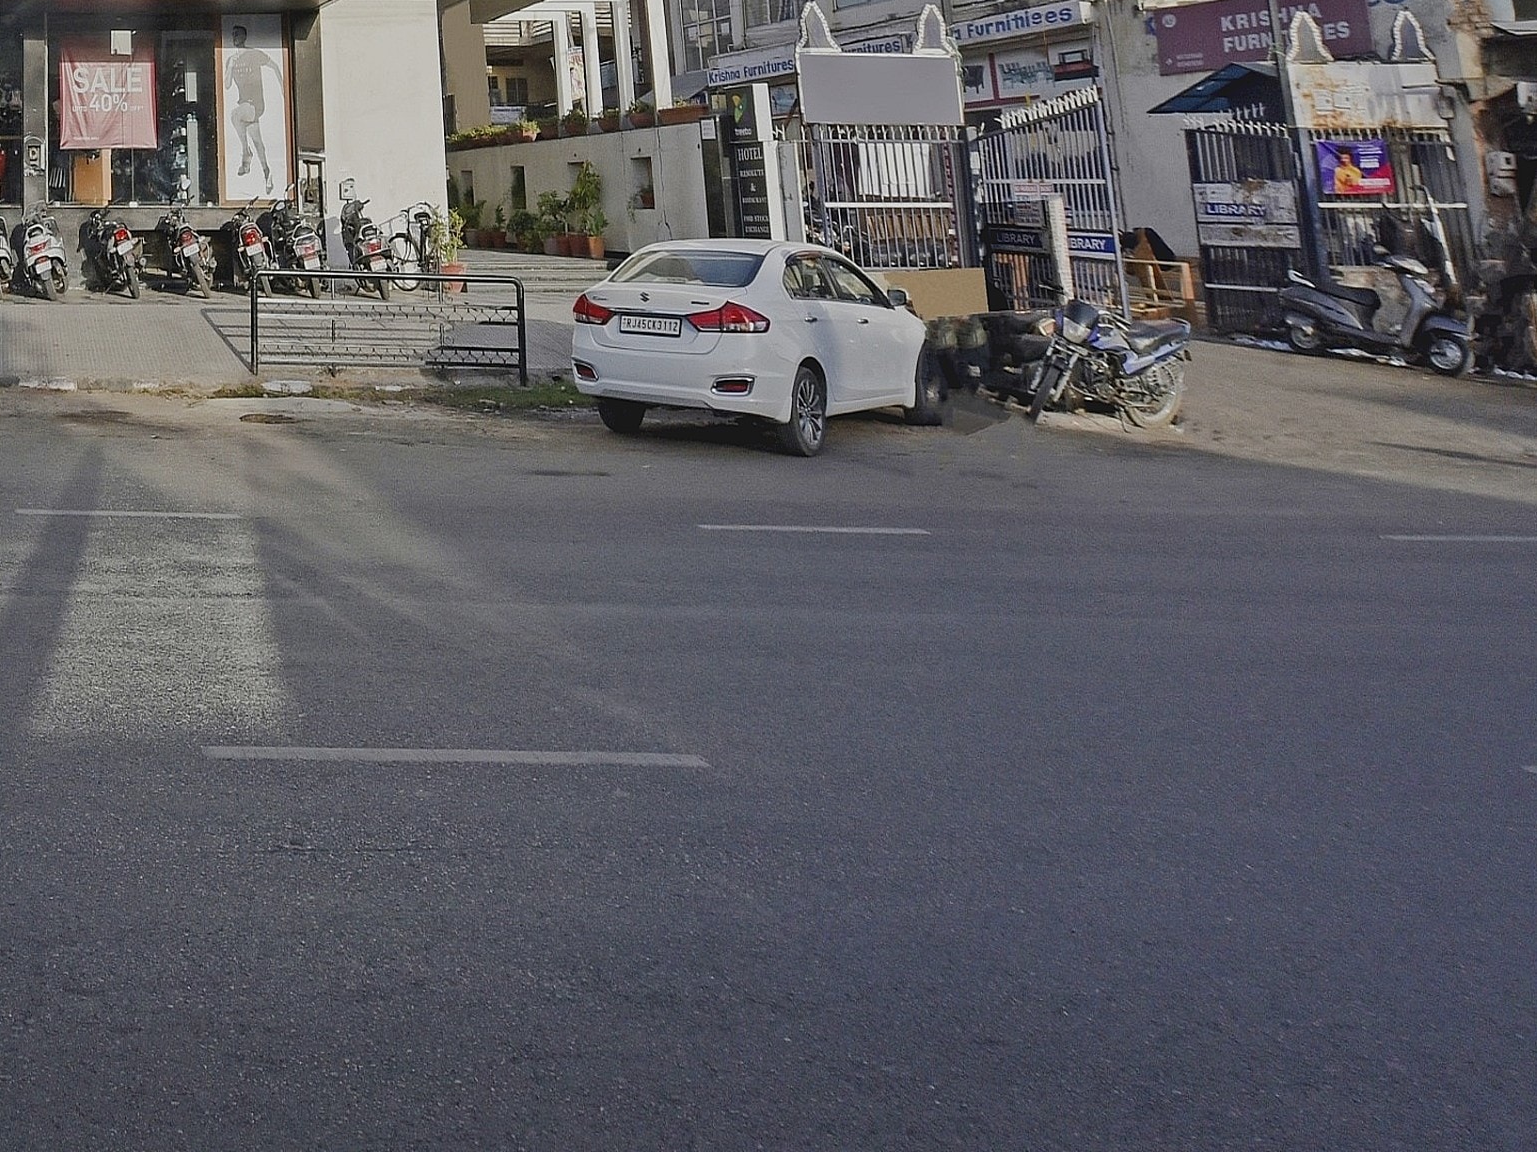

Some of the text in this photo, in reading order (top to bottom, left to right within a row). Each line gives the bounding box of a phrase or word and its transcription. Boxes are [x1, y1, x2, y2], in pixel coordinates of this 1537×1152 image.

[72, 67, 143, 94] SALE
[707, 67, 741, 85] Krishna
[90, 94, 128, 112] 40%
[737, 148, 763, 161] HOTEL
[1206, 203, 1267, 216] LIBRARY
[996, 231, 1037, 245] LIBRARY
[1070, 237, 1107, 250] BRARY
